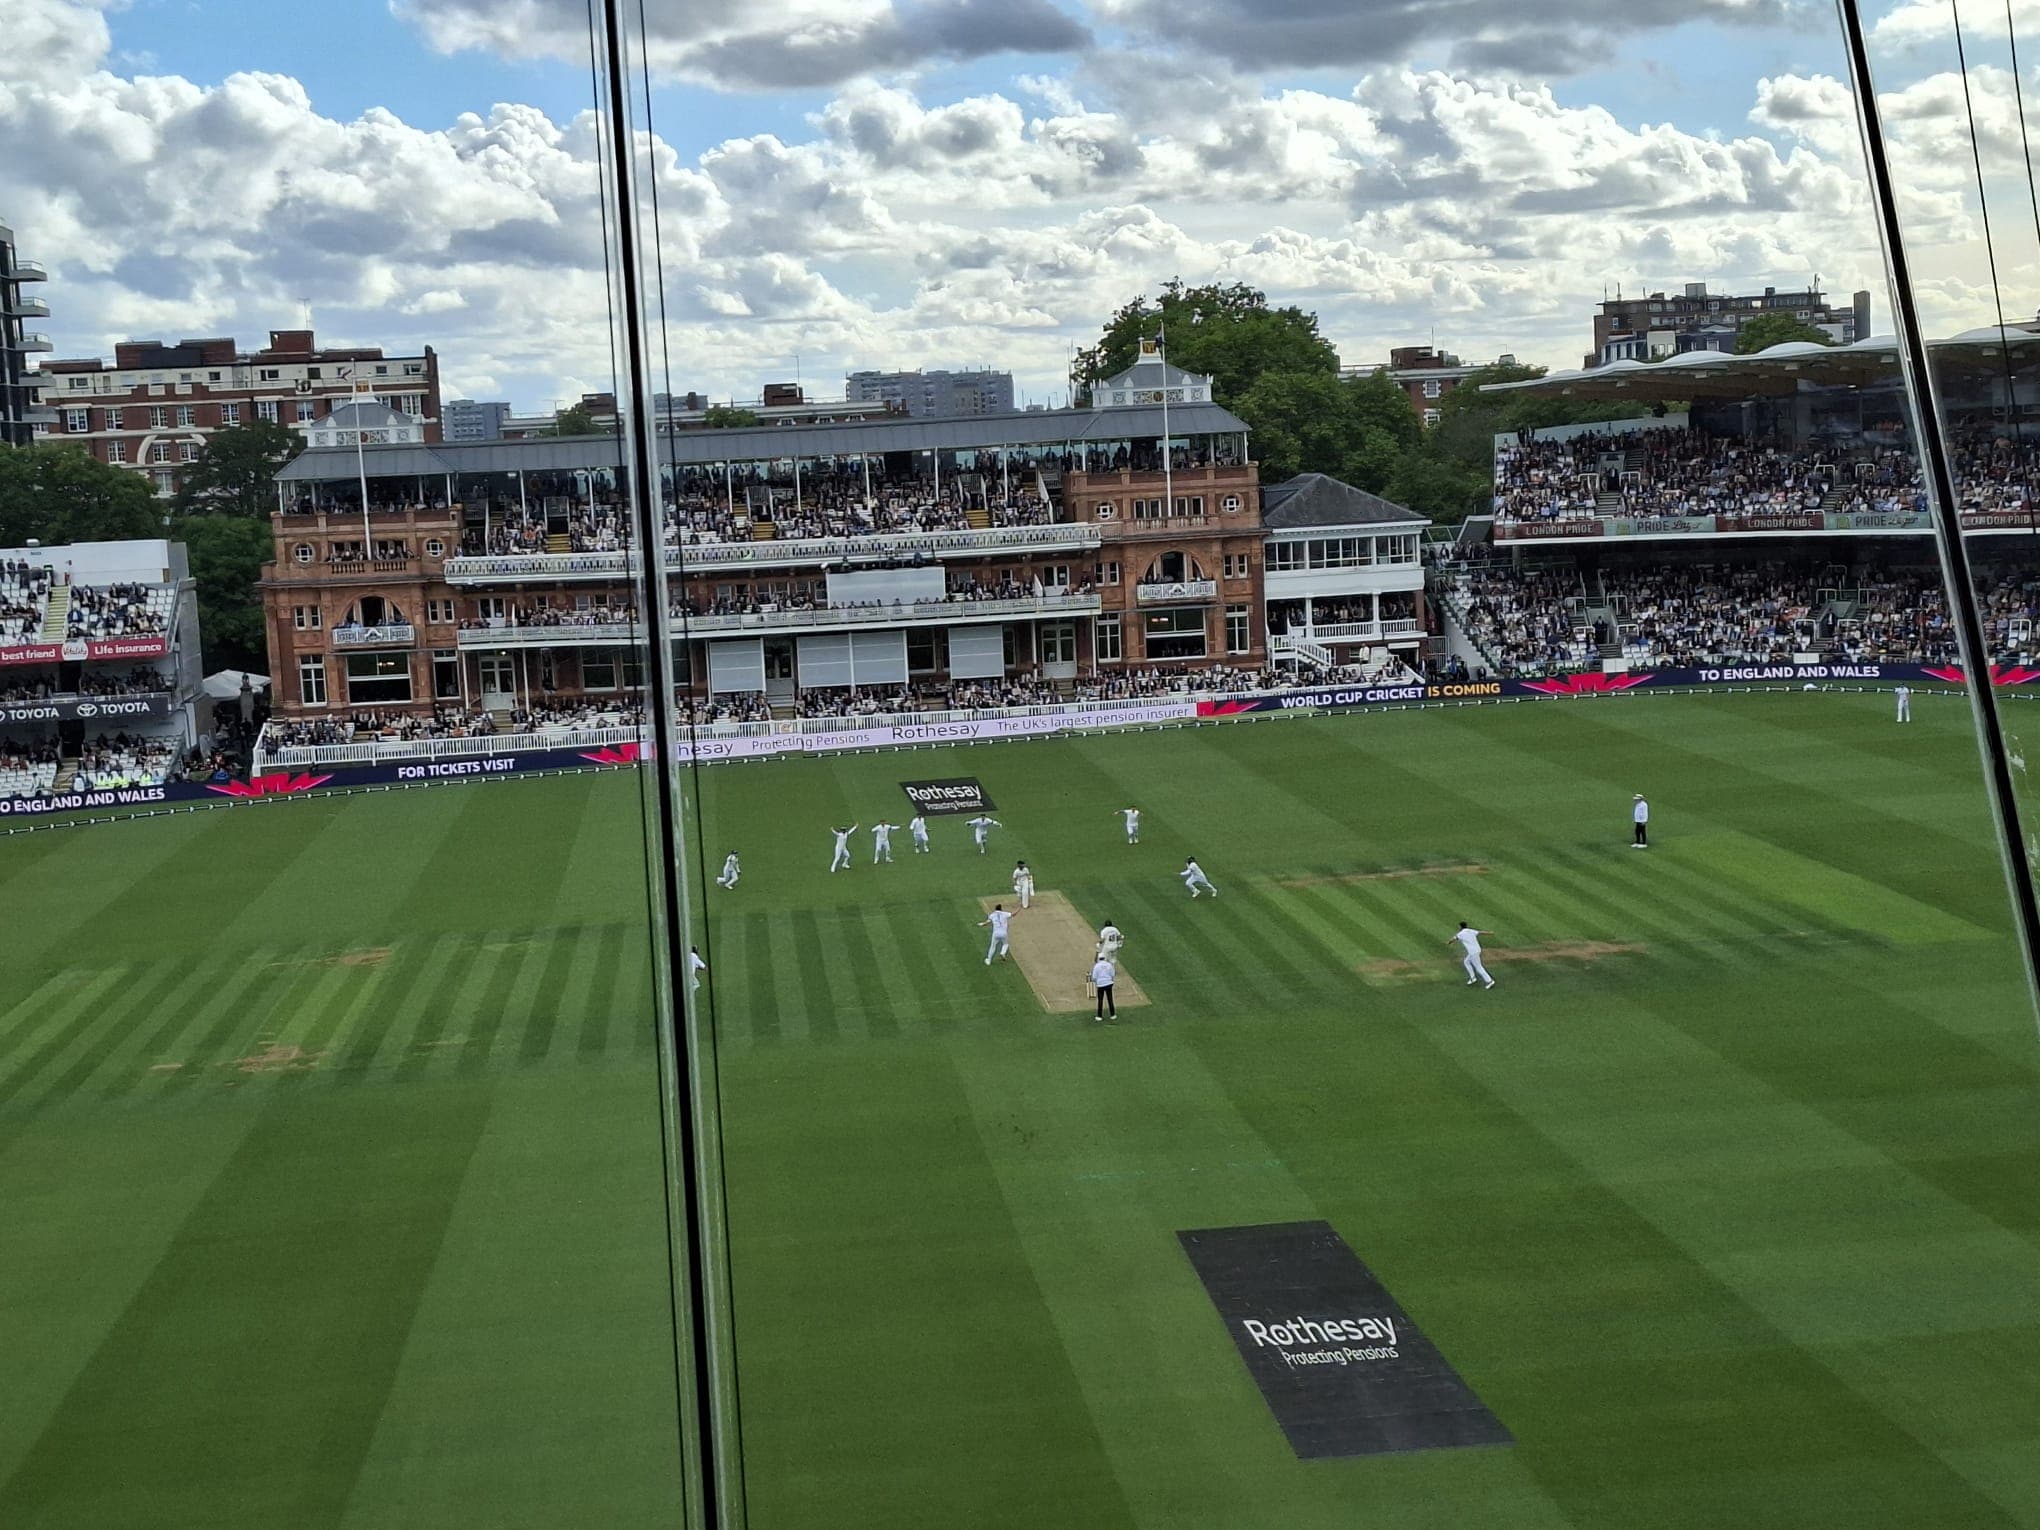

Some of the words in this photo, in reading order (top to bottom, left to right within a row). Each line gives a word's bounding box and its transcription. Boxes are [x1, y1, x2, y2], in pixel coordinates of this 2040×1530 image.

[1637, 521, 1669, 532] PRIDE
[1855, 515, 1887, 526] PRIDE
[1526, 526, 1563, 536] LONDON
[1565, 525, 1593, 535] PRIDE
[1, 653, 24, 661] best
[26, 650, 56, 658] friend
[94, 646, 113, 655] Life
[115, 644, 162, 653] insurance
[1699, 670, 1720, 681] TO
[1723, 667, 1794, 680] ENGLAND
[1797, 667, 1828, 678] AND
[1831, 666, 1881, 678] WALES
[1281, 694, 1333, 709] WORLD
[1336, 690, 1363, 703] CUP
[1365, 686, 1425, 701] CRICKET
[1427, 685, 1440, 697] IS
[1443, 682, 1501, 696] COMING
[8, 708, 60, 720] TOYOTA
[101, 702, 150, 714] TOYOTA
[816, 733, 870, 746] Pensions
[892, 723, 980, 739] Rothesay
[997, 721, 1019, 732] The
[1022, 718, 1045, 730] UK's
[1050, 715, 1092, 730] largest
[1096, 710, 1144, 725] pension
[1147, 707, 1189, 719] insurer
[398, 766, 425, 779] FOR
[428, 761, 480, 776] TICKETS
[482, 758, 515, 771] VISIT
[15, 795, 82, 812] ENGLAND
[85, 792, 115, 806] AND
[118, 788, 165, 803] WALES
[906, 784, 981, 801] Rothesay
[1243, 1316, 1398, 1347] Rothesay
[1282, 1349, 1347, 1367] Protecting
[1343, 1345, 1399, 1361] Pensions
